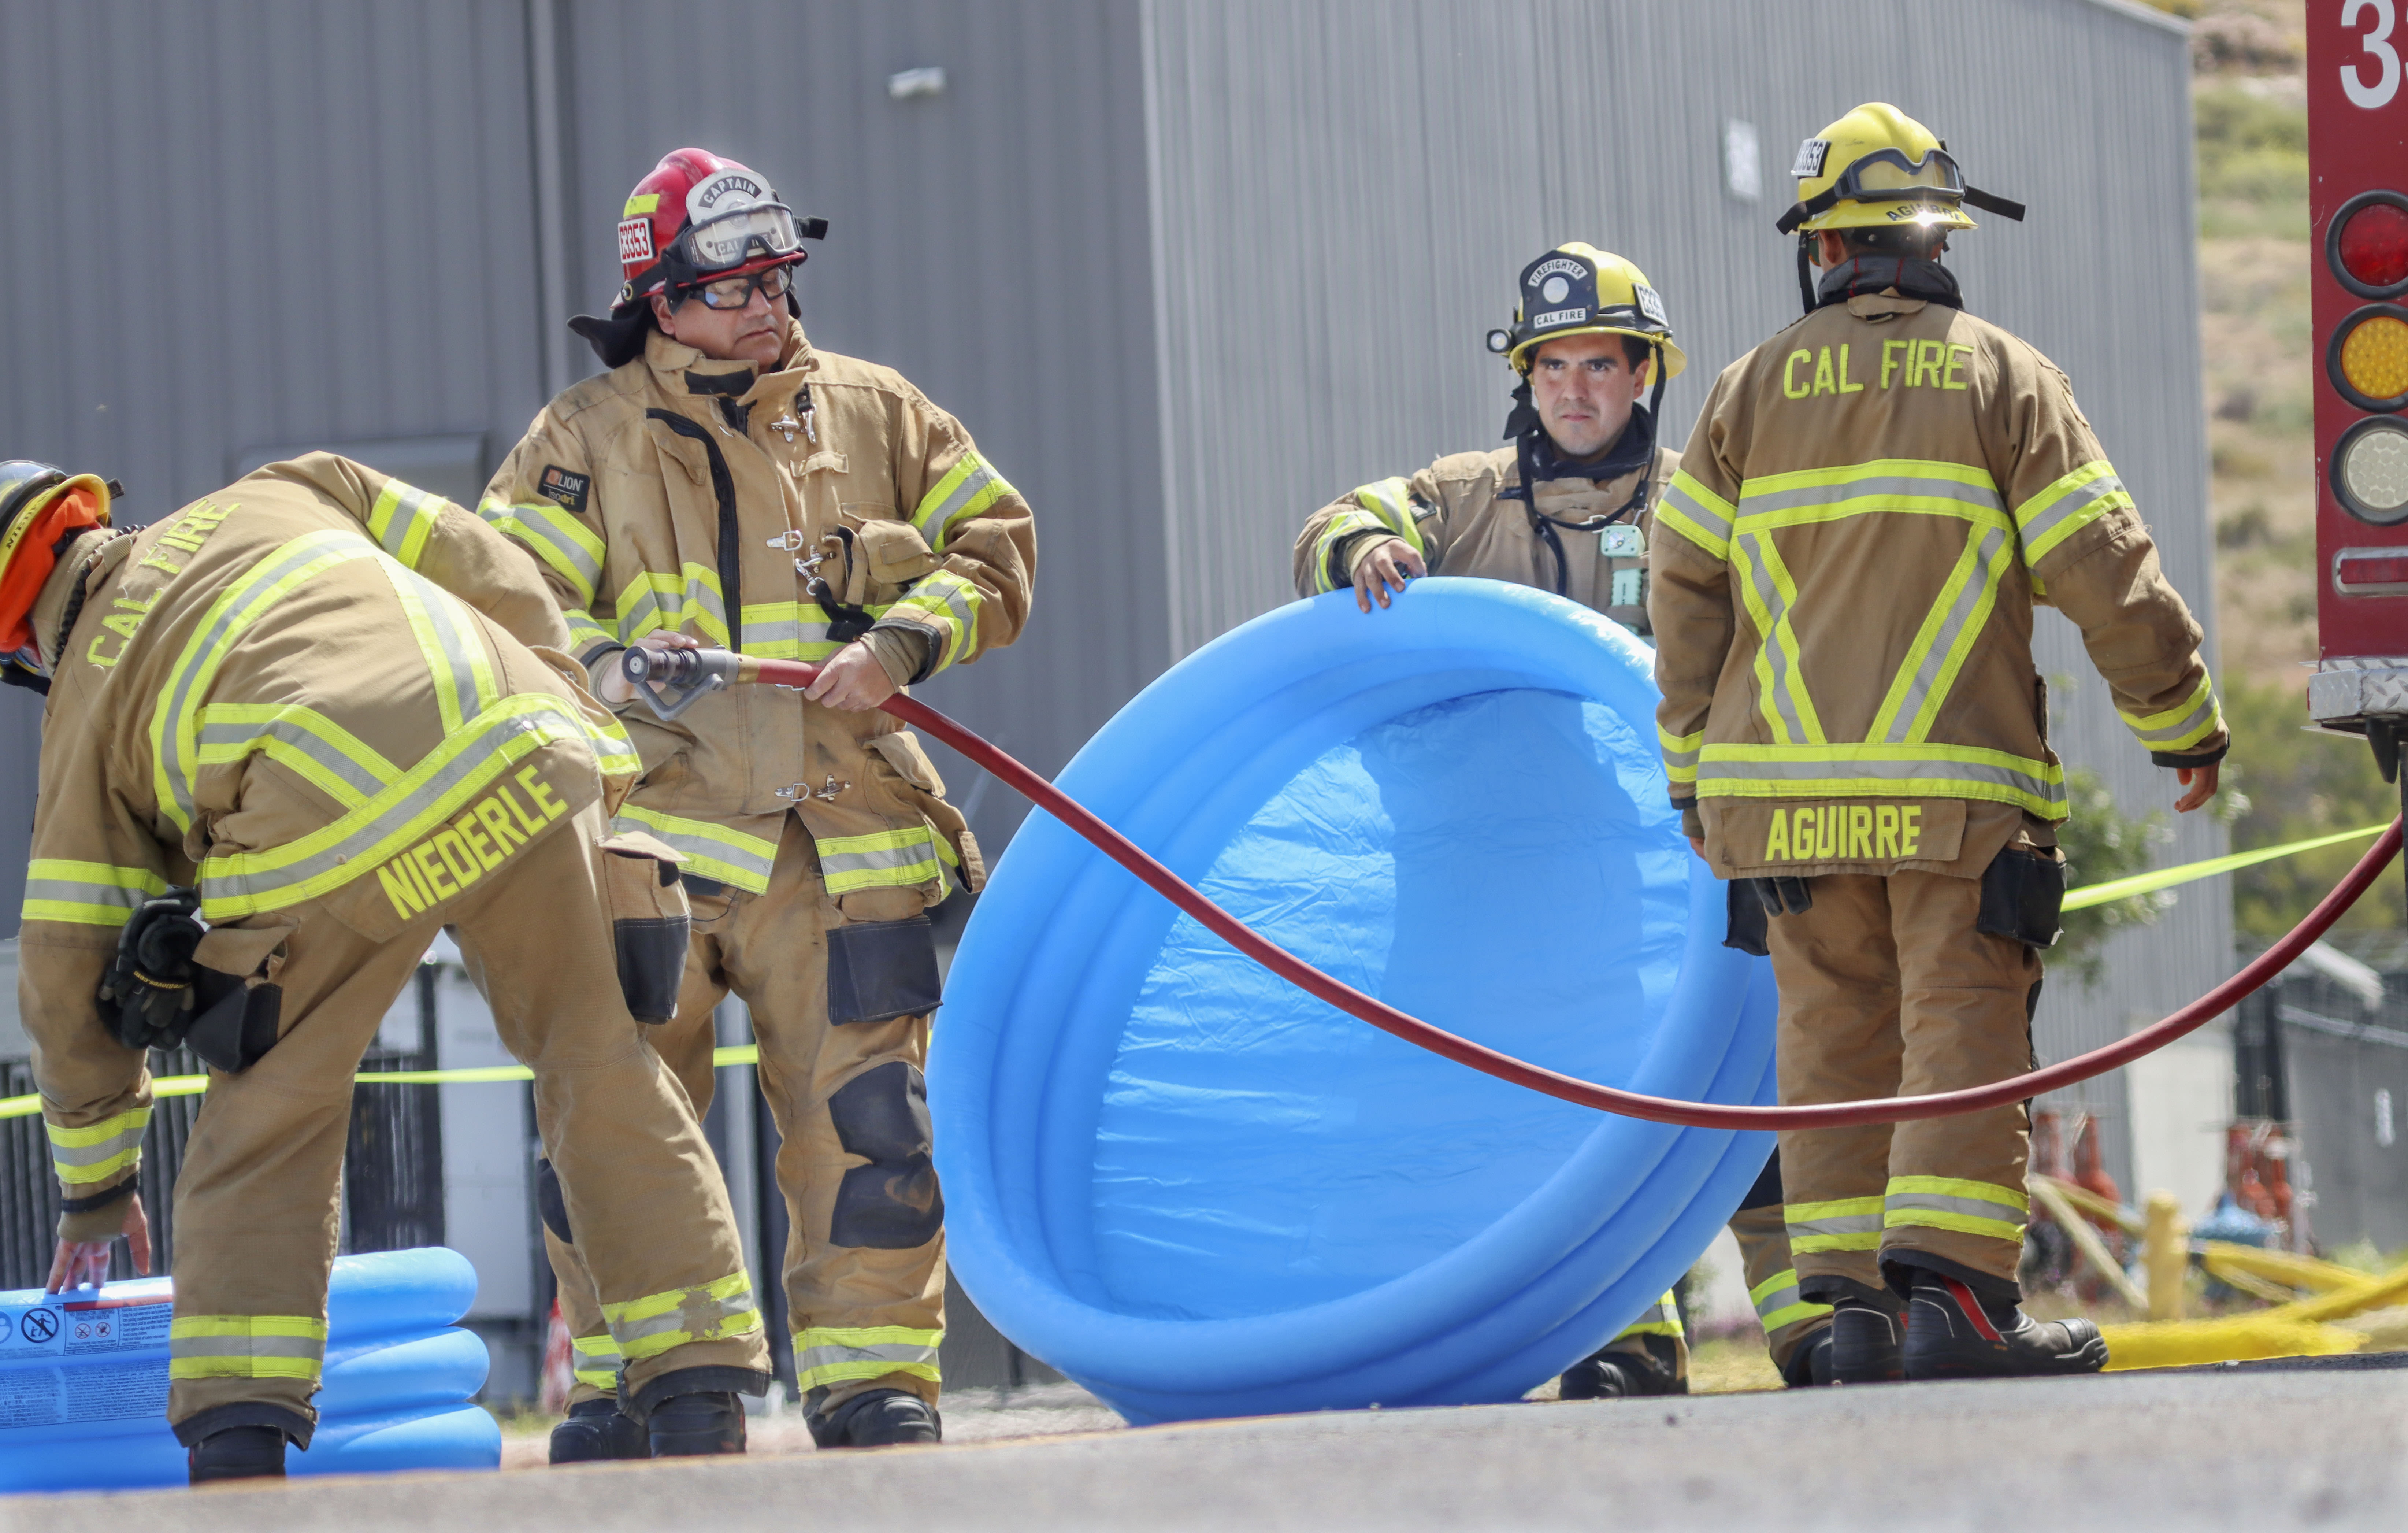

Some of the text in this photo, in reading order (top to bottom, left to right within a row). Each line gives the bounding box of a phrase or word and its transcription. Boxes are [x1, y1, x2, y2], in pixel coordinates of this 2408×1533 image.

[2340, 0, 2408, 108] 3
[703, 178, 756, 204] CAPTAIN
[1886, 203, 1962, 222] AGURRE
[619, 222, 649, 260] E3353
[1532, 260, 1584, 284] FIREFIGHTER
[1536, 310, 1583, 325] CAL FIRE
[1783, 338, 1974, 400] CAL FIRE
[557, 474, 582, 492] LION
[87, 499, 241, 667] CAL FIRE
[376, 764, 568, 920] NIEDERLE
[1764, 804, 1922, 861] AGUIRRE
